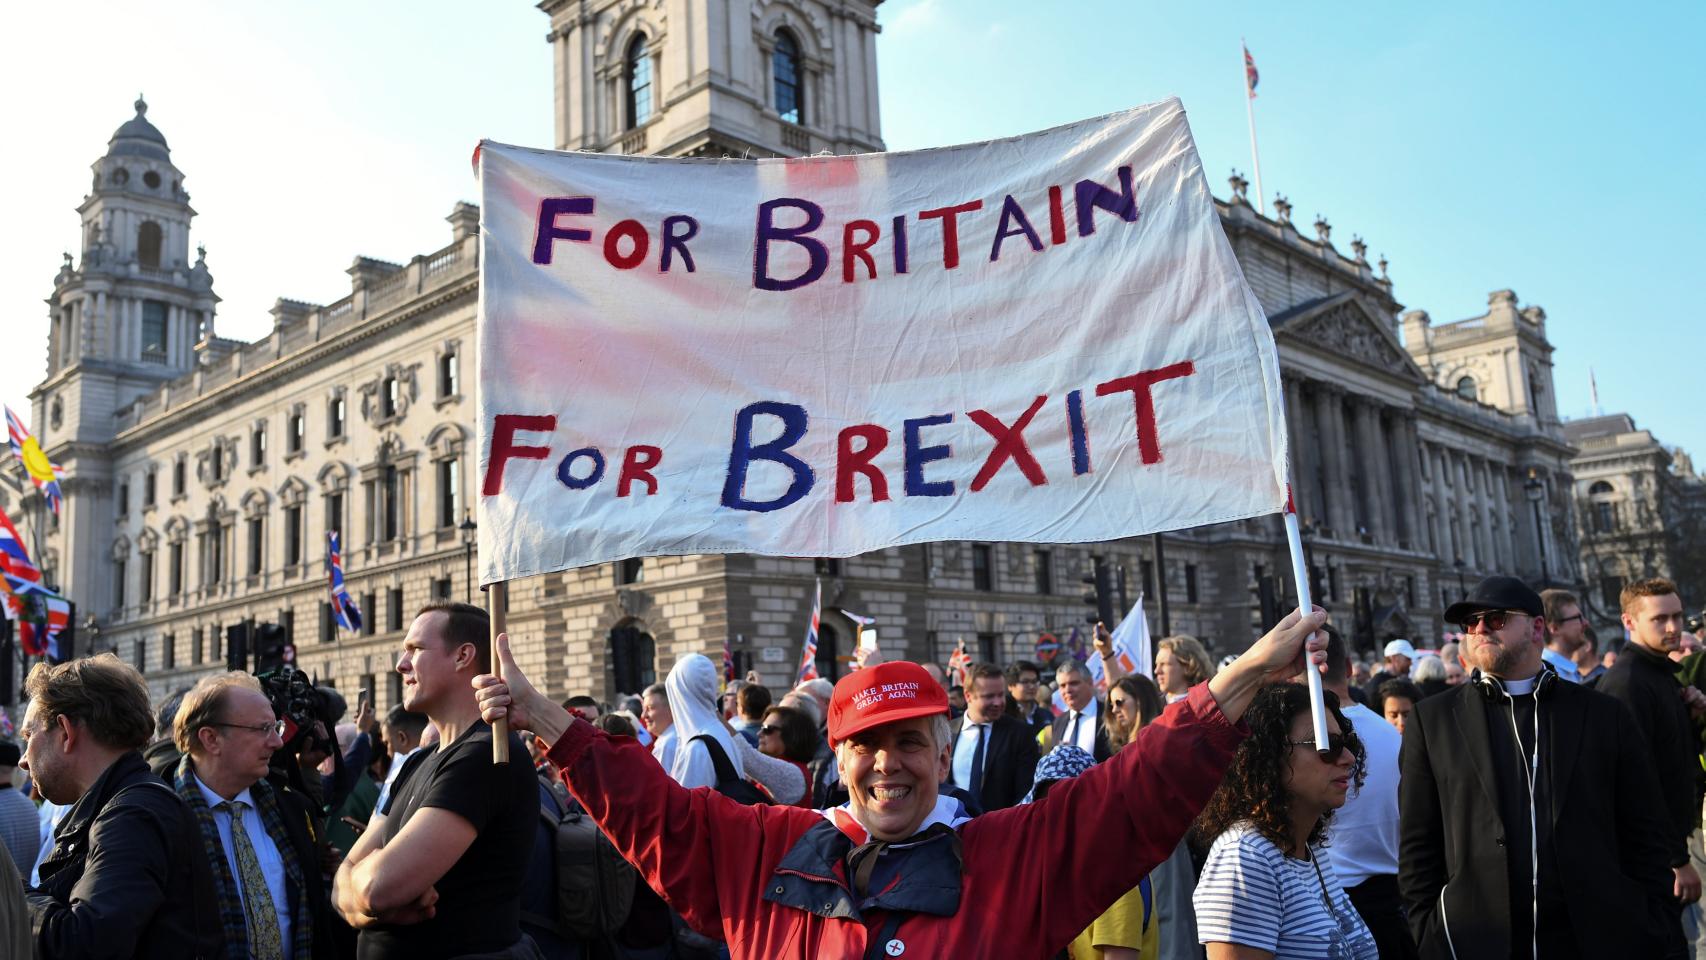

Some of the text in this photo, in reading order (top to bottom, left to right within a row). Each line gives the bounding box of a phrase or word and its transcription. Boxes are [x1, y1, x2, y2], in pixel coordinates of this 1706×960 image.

[755, 166, 1137, 291] BRITAIN
[721, 361, 1194, 513] BREXIT
[852, 682, 919, 704] MAKE BRITAIN
[856, 690, 916, 710] GREAT AGAIN
